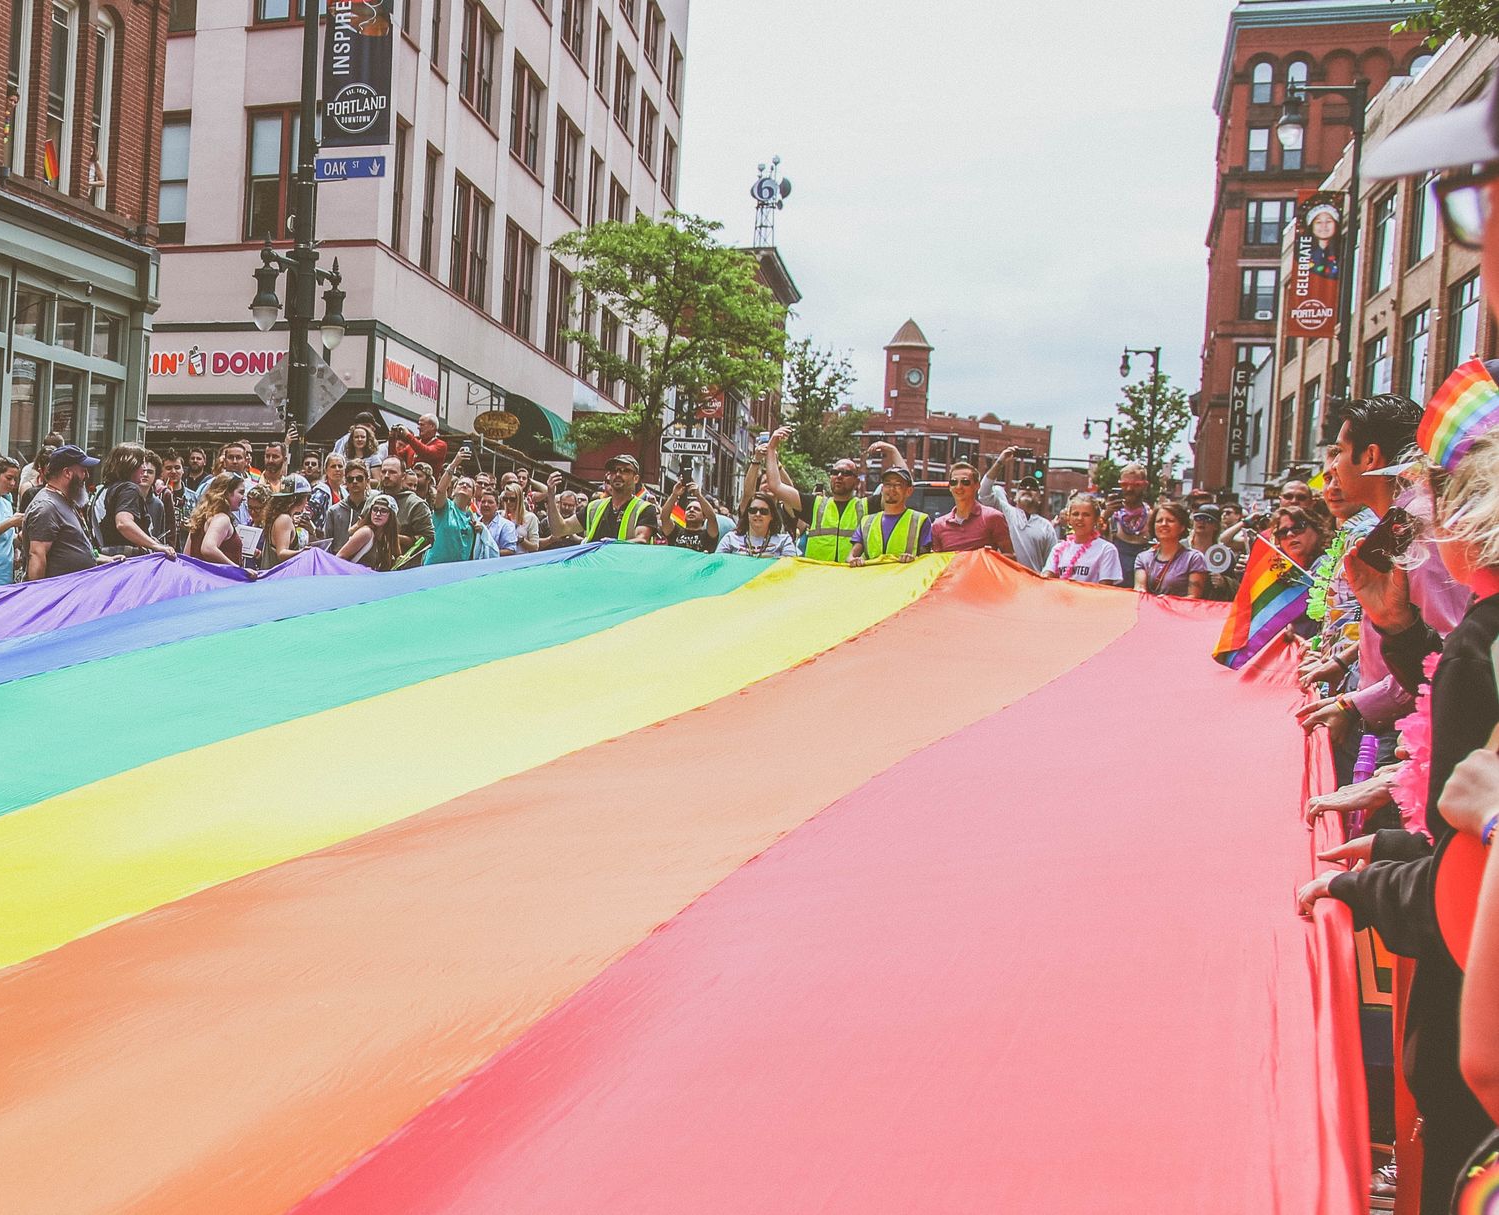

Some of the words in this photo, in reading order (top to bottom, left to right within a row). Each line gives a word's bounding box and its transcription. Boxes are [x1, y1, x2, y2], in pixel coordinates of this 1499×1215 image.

[333, 0, 357, 75] INSPIRE
[326, 96, 387, 116] PORTLAND
[341, 115, 371, 124] DOWNTOWN
[323, 162, 347, 176] OAK
[1296, 236, 1312, 296] CELEBRATE
[1291, 308, 1333, 318] PORTLAND
[149, 352, 185, 375] IN'
[1231, 371, 1247, 455] EMPIRE
[672, 442, 688, 450] ONE
